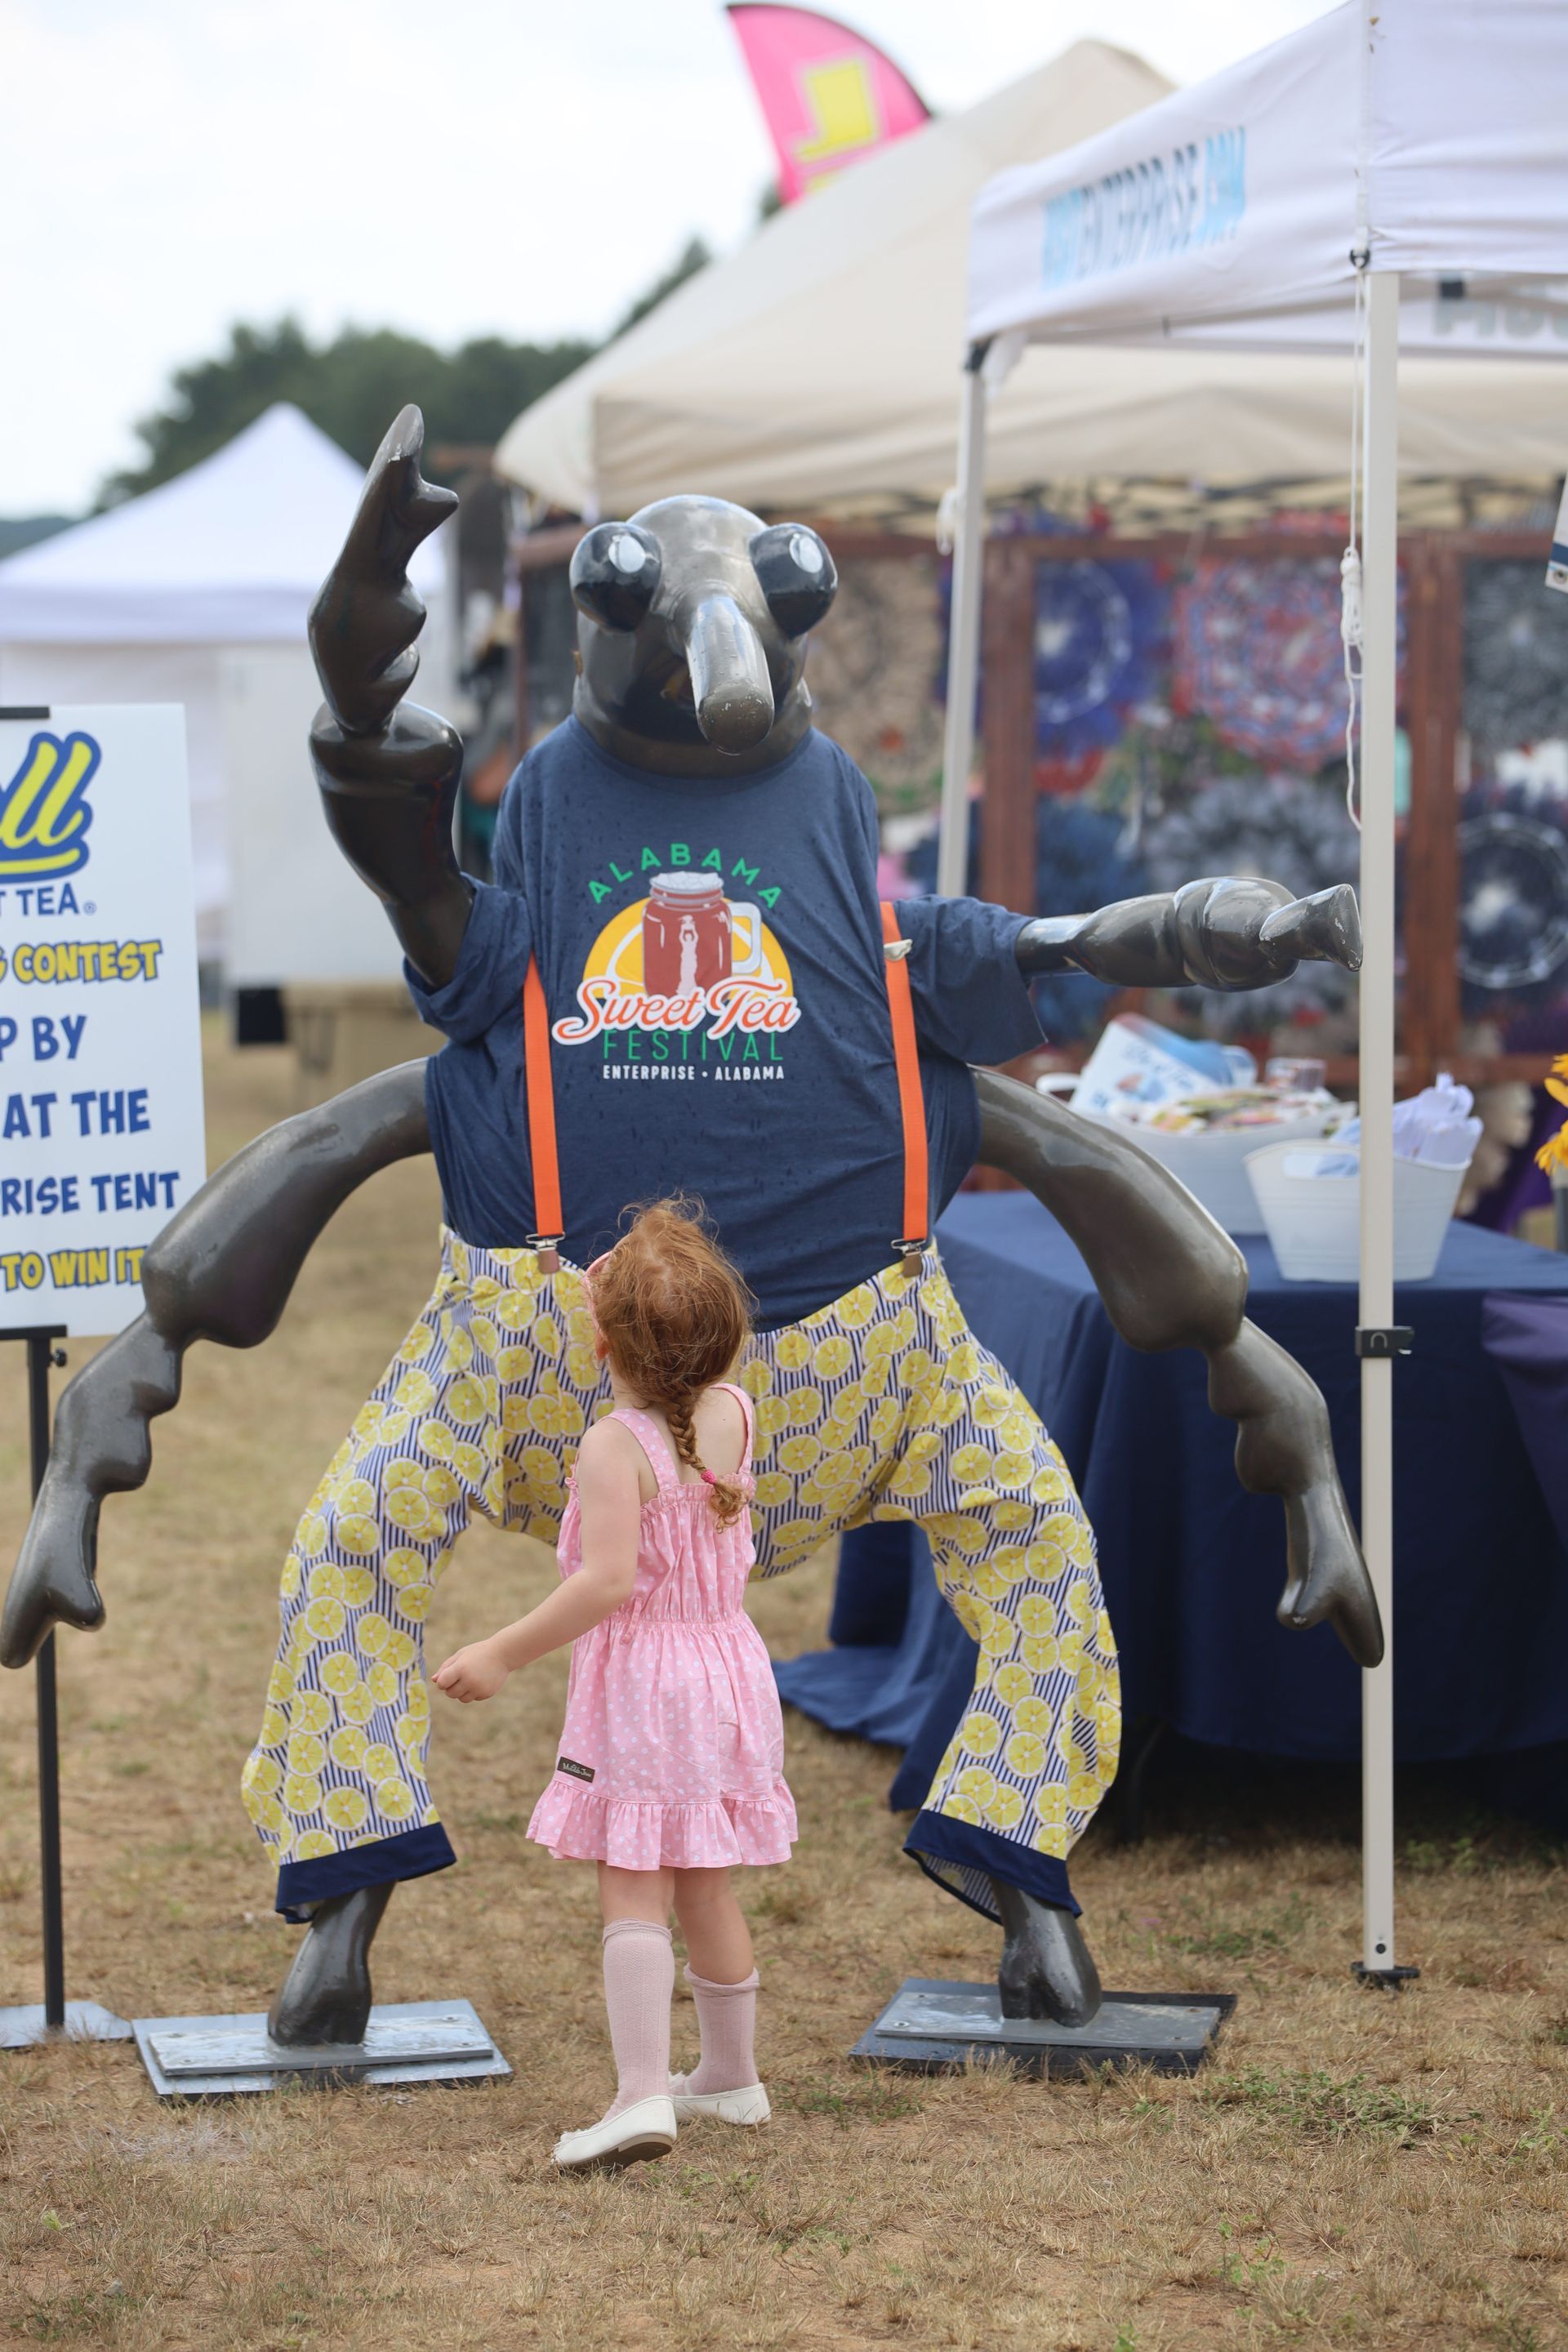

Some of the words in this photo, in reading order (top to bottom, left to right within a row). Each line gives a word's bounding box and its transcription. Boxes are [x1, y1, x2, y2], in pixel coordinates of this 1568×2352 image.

[588, 843, 782, 909] ALABAMA
[13, 939, 163, 984] CONTEST
[552, 979, 706, 1045] Sweet
[706, 976, 802, 1040] Tea
[32, 1015, 87, 1061] BY
[603, 1030, 784, 1061] FESTIVAL
[603, 1065, 695, 1080] ENTERPRISE
[715, 1065, 784, 1080] ALABAMA
[2, 1092, 57, 1138] AT
[71, 1089, 150, 1137] THE
[91, 1171, 180, 1213] TENT
[0, 1252, 45, 1292] TO
[47, 1247, 109, 1289] WIN
